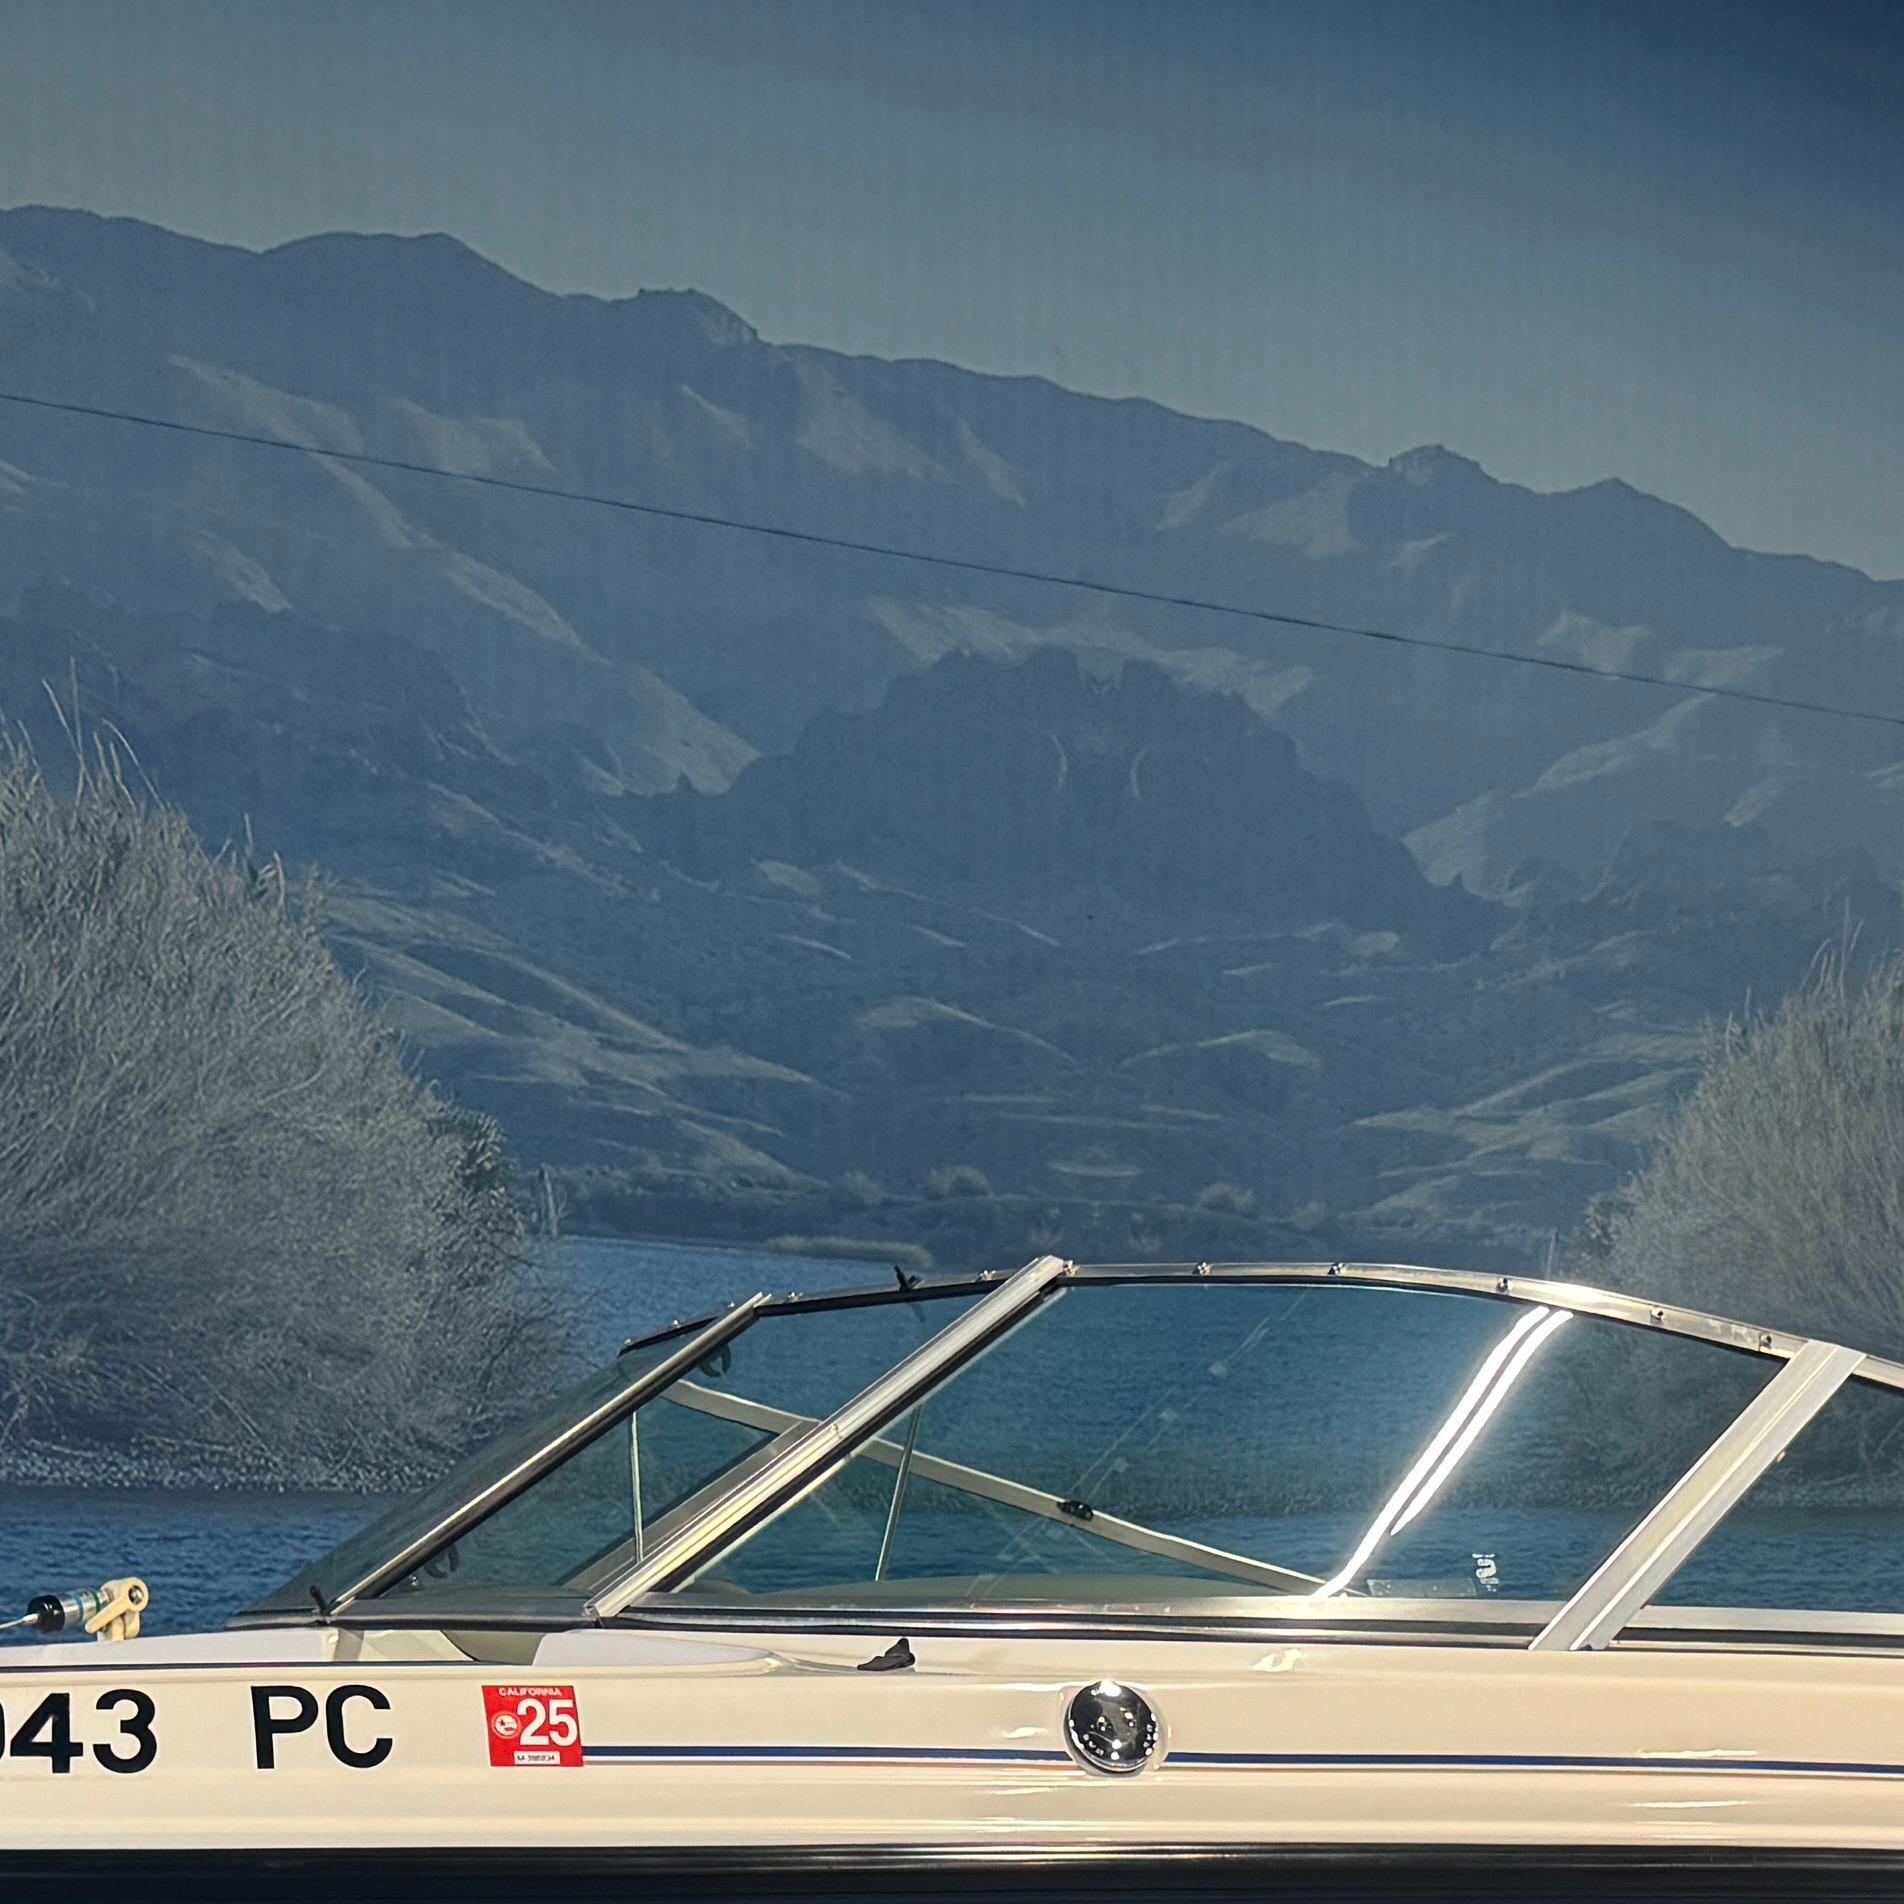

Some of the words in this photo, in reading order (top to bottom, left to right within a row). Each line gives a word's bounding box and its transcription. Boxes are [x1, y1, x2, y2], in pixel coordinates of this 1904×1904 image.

[498, 1687, 563, 1697] CALIFORNIA
[250, 1684, 393, 1769] PC
[516, 1697, 578, 1747] 25
